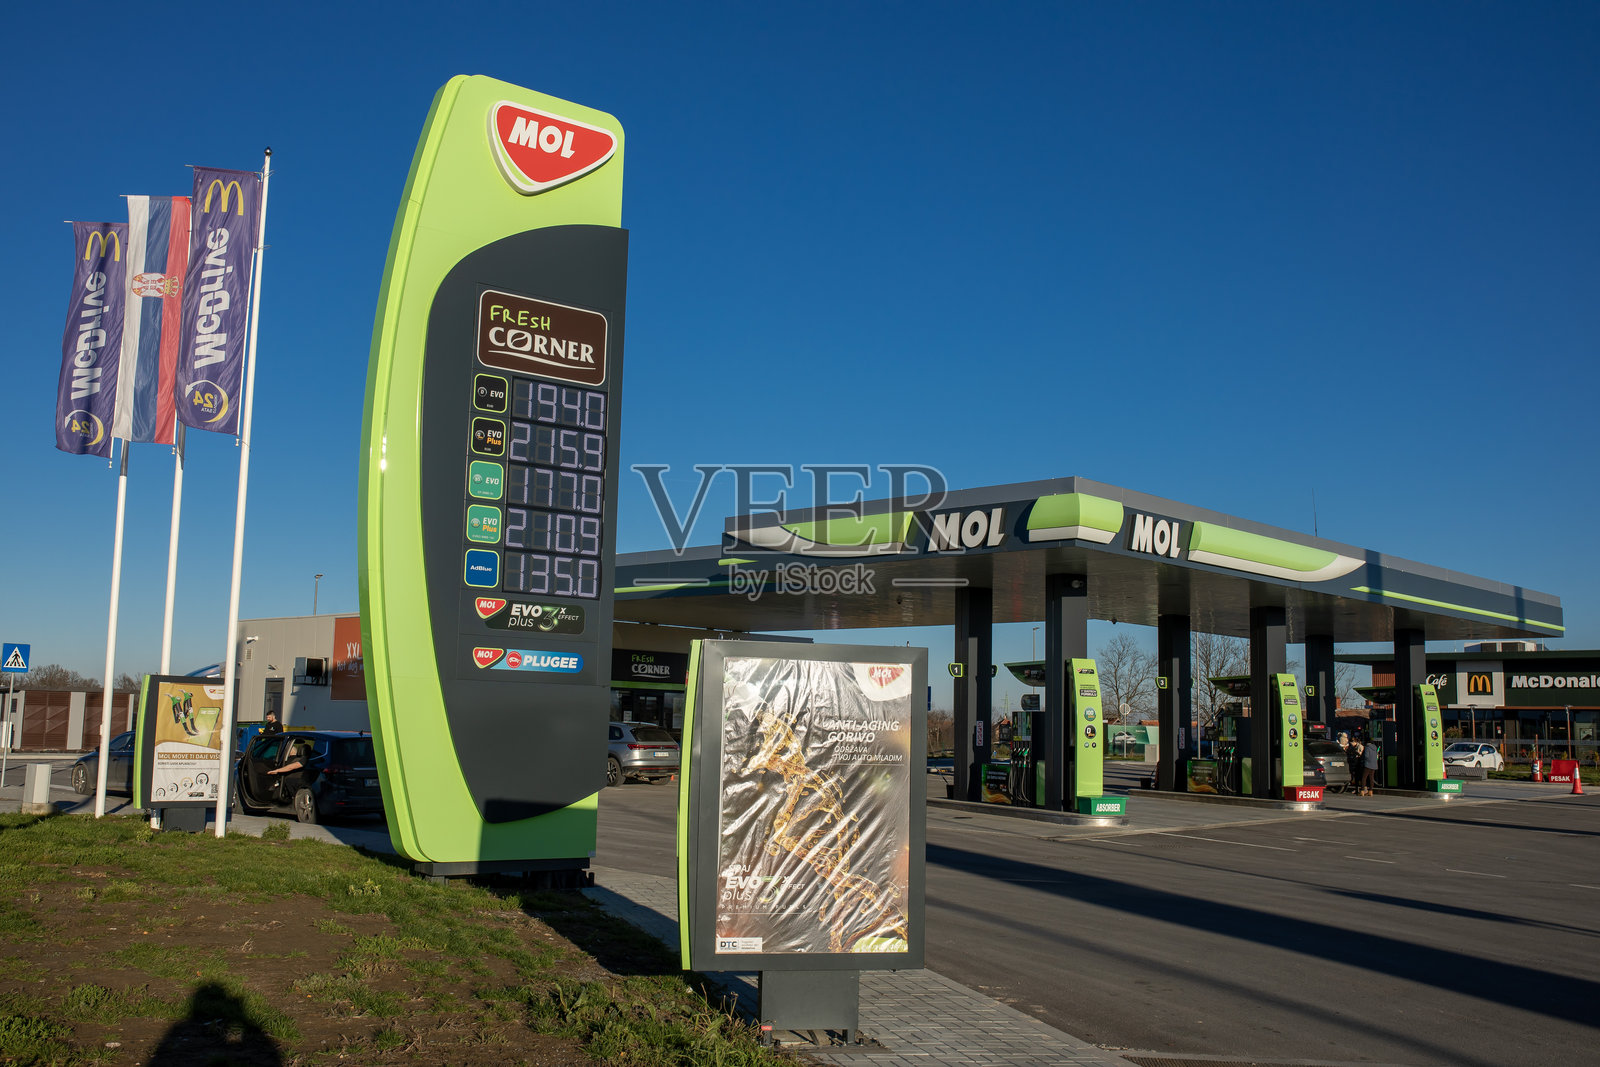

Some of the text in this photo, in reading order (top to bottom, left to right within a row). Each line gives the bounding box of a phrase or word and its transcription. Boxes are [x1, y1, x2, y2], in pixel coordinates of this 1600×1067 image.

[508, 116, 575, 159] MOL
[490, 304, 551, 331] FRESH
[488, 326, 595, 364] CORNER
[490, 390, 504, 398] EVO
[528, 382, 605, 430] 194.0
[486, 437, 502, 446] Plus
[487, 421, 603, 471] EVO 215.9
[485, 477, 500, 485] EVO
[523, 468, 602, 514] 177.0
[482, 524, 497, 533] Plus
[482, 508, 600, 555] EVO 210.9
[928, 508, 1005, 552] MOL
[1131, 513, 1181, 559] MOL
[470, 554, 598, 598] AdBlue 135.0
[479, 600, 496, 609] MOL
[511, 603, 543, 618] EVO
[538, 605, 561, 631] 3
[508, 615, 535, 628] plus
[476, 650, 579, 669] MOL PLUGEE
[631, 654, 655, 663] FRESH
[631, 663, 671, 675] CORNER
[872, 667, 892, 679] MOL
[954, 666, 959, 674] 1
[1425, 673, 1448, 689] Café
[831, 720, 900, 732] ANTI-AGING
[827, 731, 876, 743] GORIVO
[210, 752, 220, 760] VIŠ
[873, 754, 903, 762] MLADIM
[1298, 790, 1320, 799] PESAK
[1095, 803, 1121, 812] ABSORBER
[725, 876, 762, 889] EVO
[722, 887, 752, 902] plus
